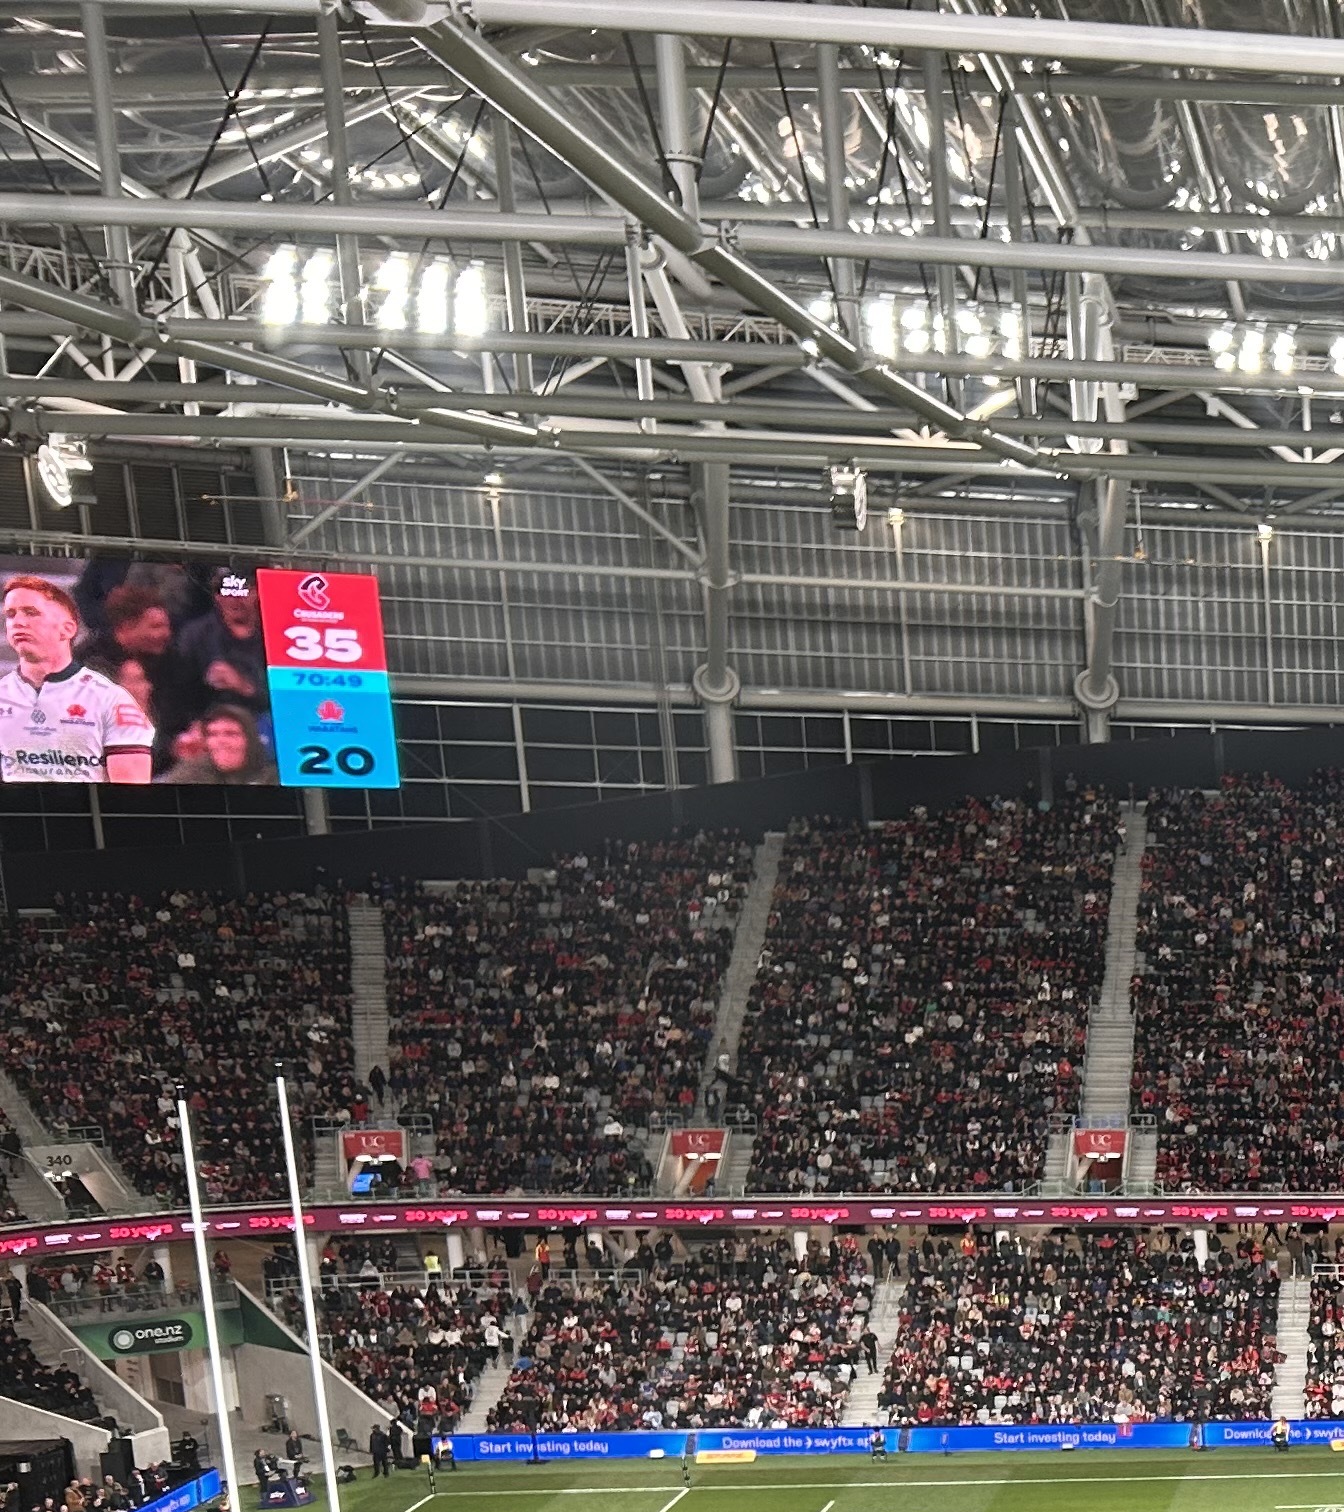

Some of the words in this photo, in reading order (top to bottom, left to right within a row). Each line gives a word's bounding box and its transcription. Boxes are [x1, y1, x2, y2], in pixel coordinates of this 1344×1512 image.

[222, 574, 247, 589] sky
[284, 626, 362, 663] 35
[292, 672, 363, 688] 70:49
[298, 745, 375, 777] 20
[361, 1136, 385, 1147] UC
[688, 1134, 710, 1146] UC
[1089, 1134, 1111, 1146] UC
[46, 1154, 72, 1166] 340
[134, 1324, 182, 1339] one.nz
[722, 1436, 782, 1449] Download
[784, 1436, 803, 1449] the
[813, 1436, 853, 1450] swyftx
[994, 1432, 1026, 1444] Start
[1028, 1432, 1080, 1446] investing
[1082, 1432, 1116, 1446] today
[480, 1441, 512, 1453] Start
[574, 1440, 609, 1455] today
